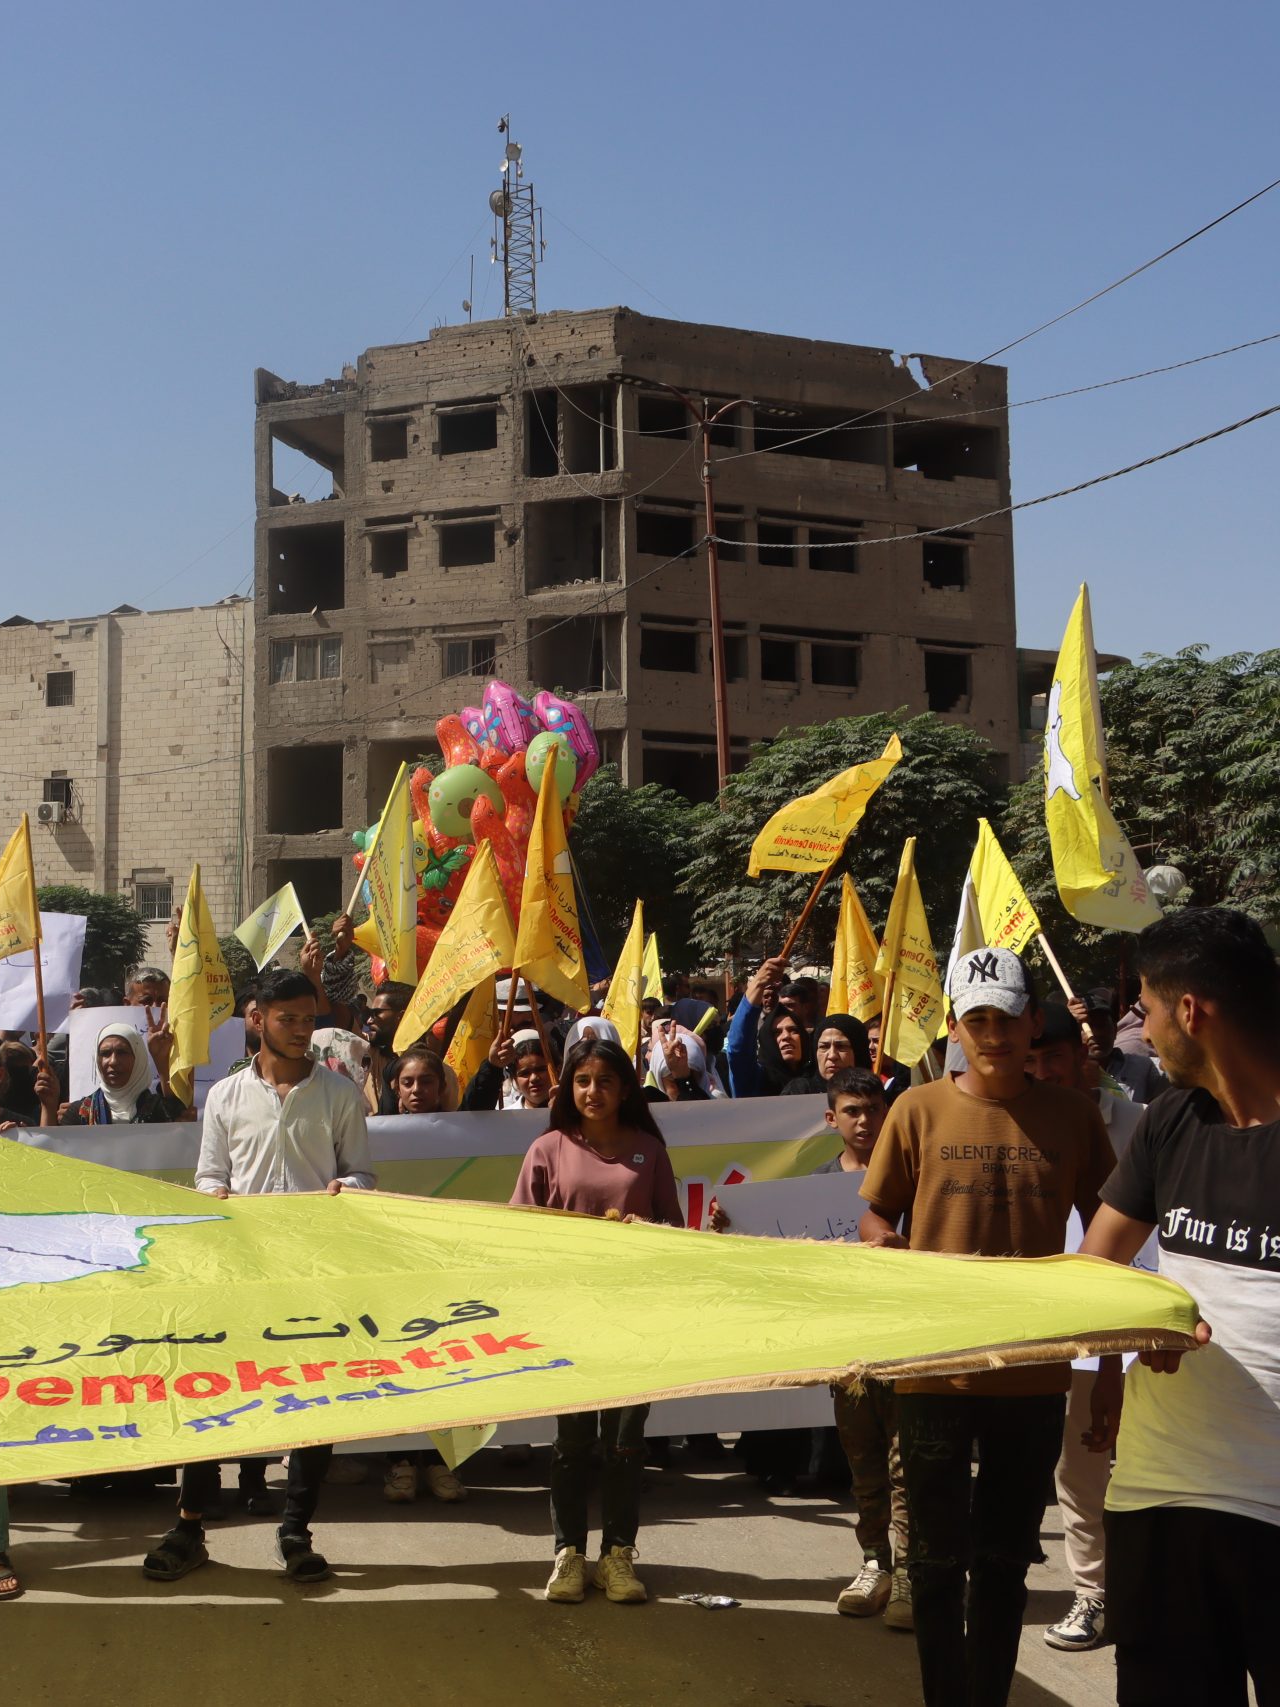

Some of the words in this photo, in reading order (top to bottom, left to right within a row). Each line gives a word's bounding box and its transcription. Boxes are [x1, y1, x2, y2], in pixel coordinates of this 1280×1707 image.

[940, 1145, 993, 1160] SILENT
[996, 1146, 1060, 1162] SCREAM
[982, 1163, 1019, 1174] BRAVE
[1161, 1206, 1217, 1245] Fun
[1225, 1219, 1251, 1252] is
[261, 1299, 500, 1344] قوات
